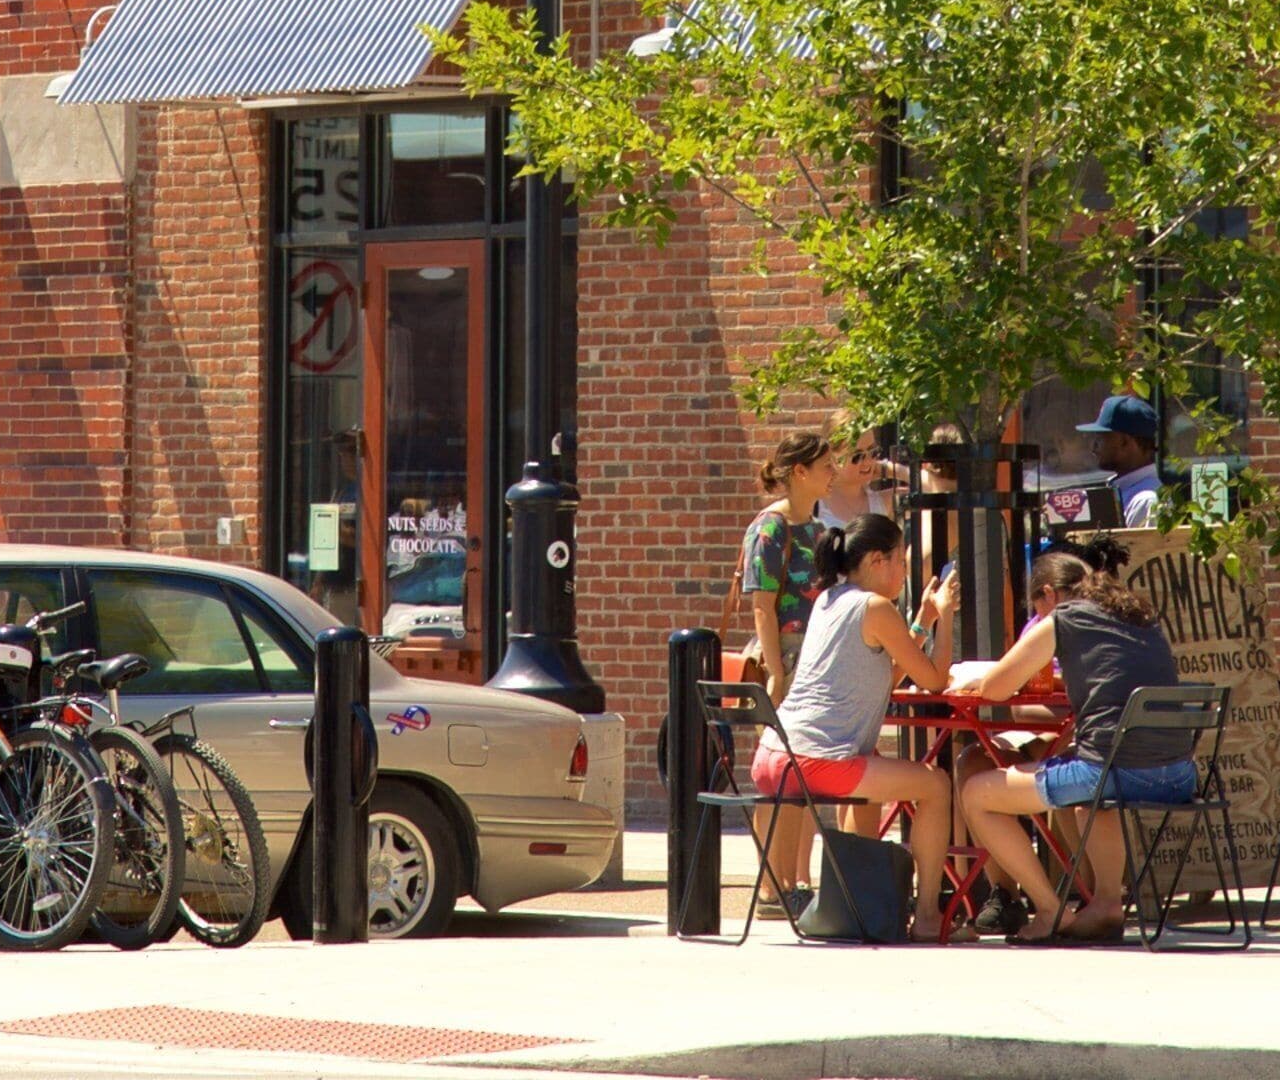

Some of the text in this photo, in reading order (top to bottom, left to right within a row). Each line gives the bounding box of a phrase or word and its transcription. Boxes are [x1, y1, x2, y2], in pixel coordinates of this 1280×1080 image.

[1054, 494, 1081, 508] SBG
[388, 516, 418, 534] NUTS,
[420, 517, 453, 533] SEEDS
[391, 537, 457, 554] CHOCOLATE
[1230, 777, 1255, 793] BAR
